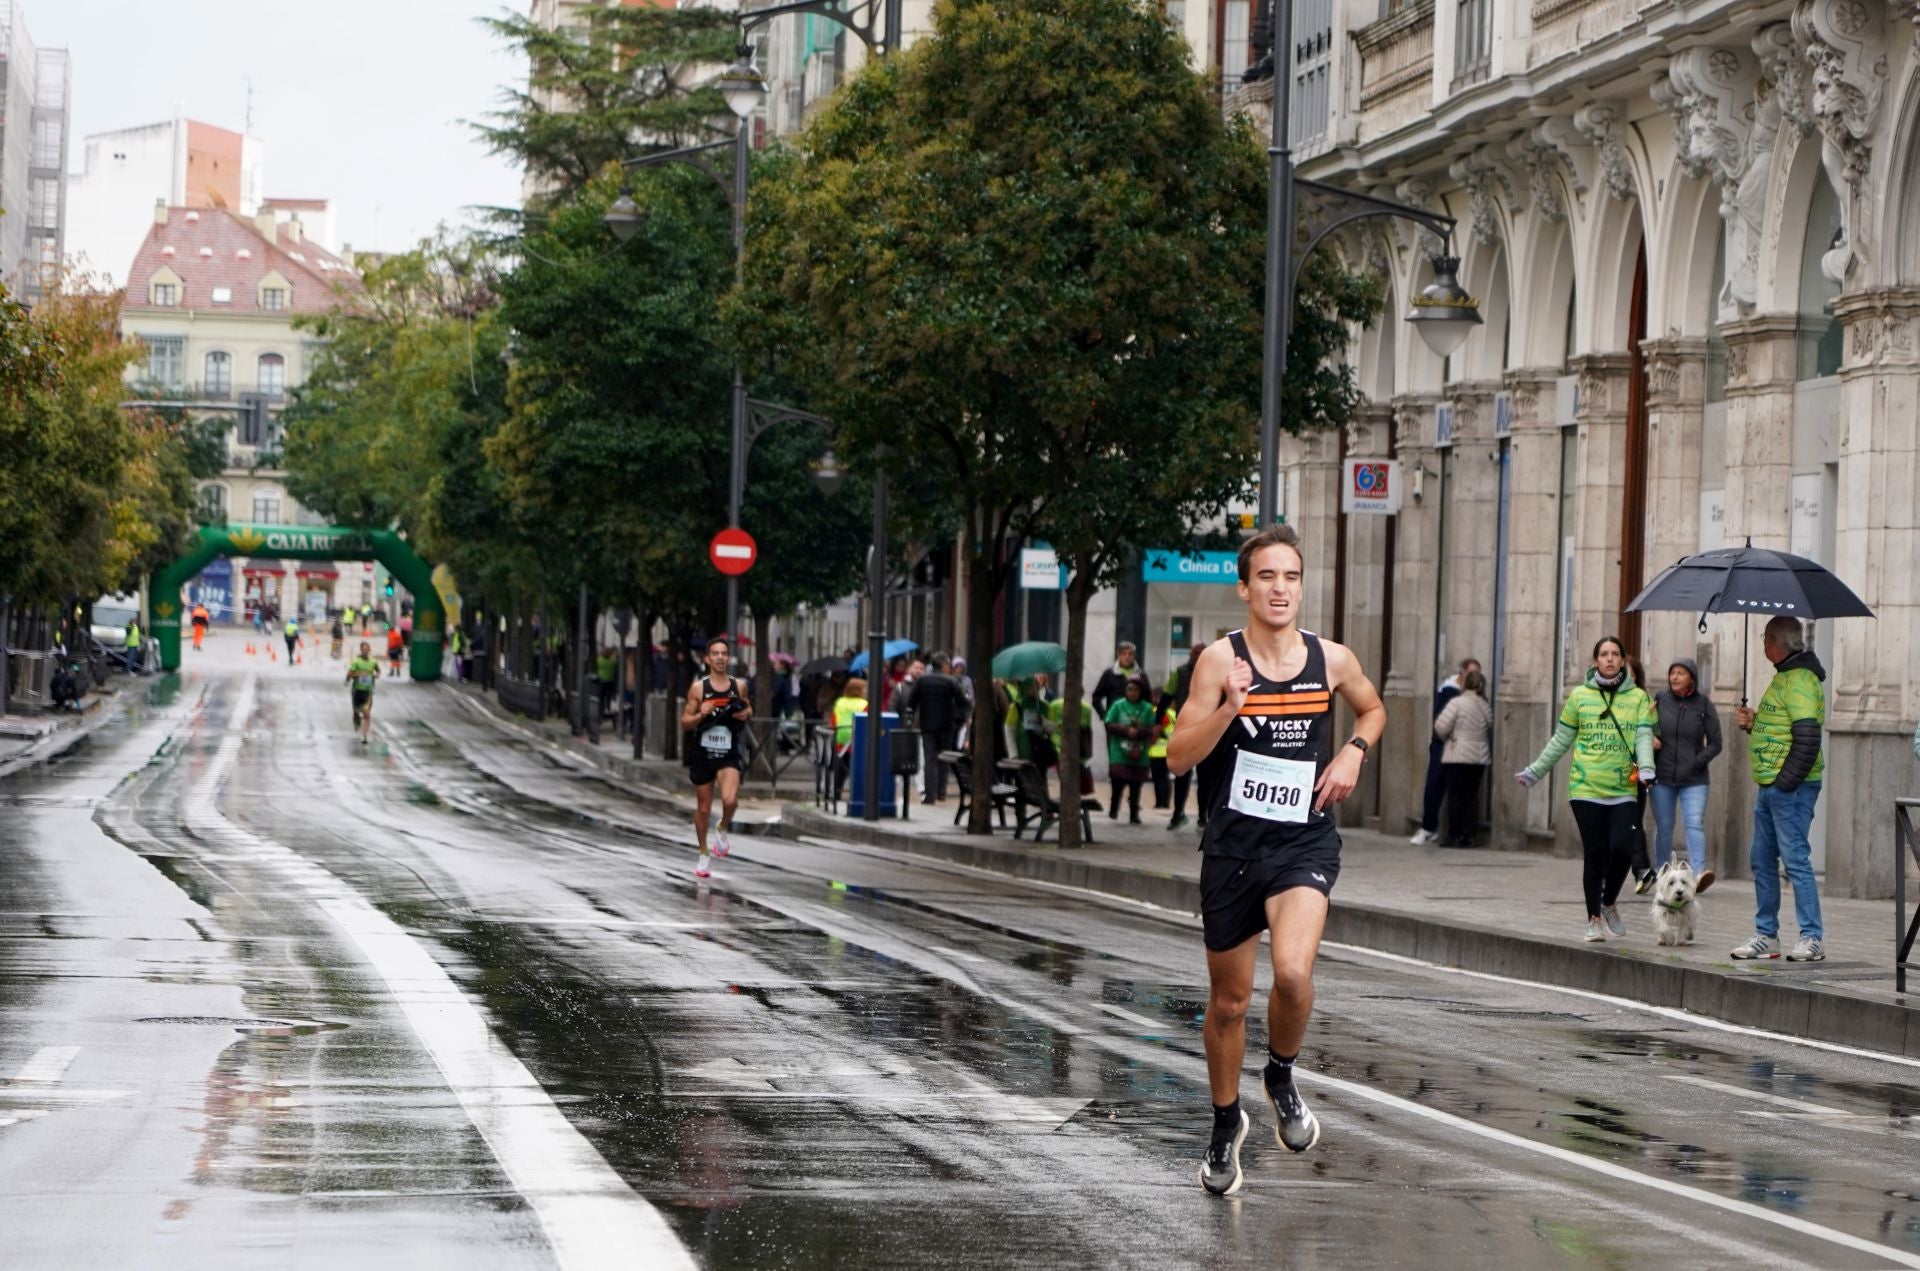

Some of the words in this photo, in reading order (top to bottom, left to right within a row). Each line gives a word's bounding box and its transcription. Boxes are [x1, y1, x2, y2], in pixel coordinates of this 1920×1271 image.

[266, 532, 308, 550] CAJA
[1737, 599, 1795, 609] VOLVO
[1269, 719, 1312, 731] VICKY
[1273, 731, 1307, 740] FOODS
[1242, 779, 1302, 807] 50130
